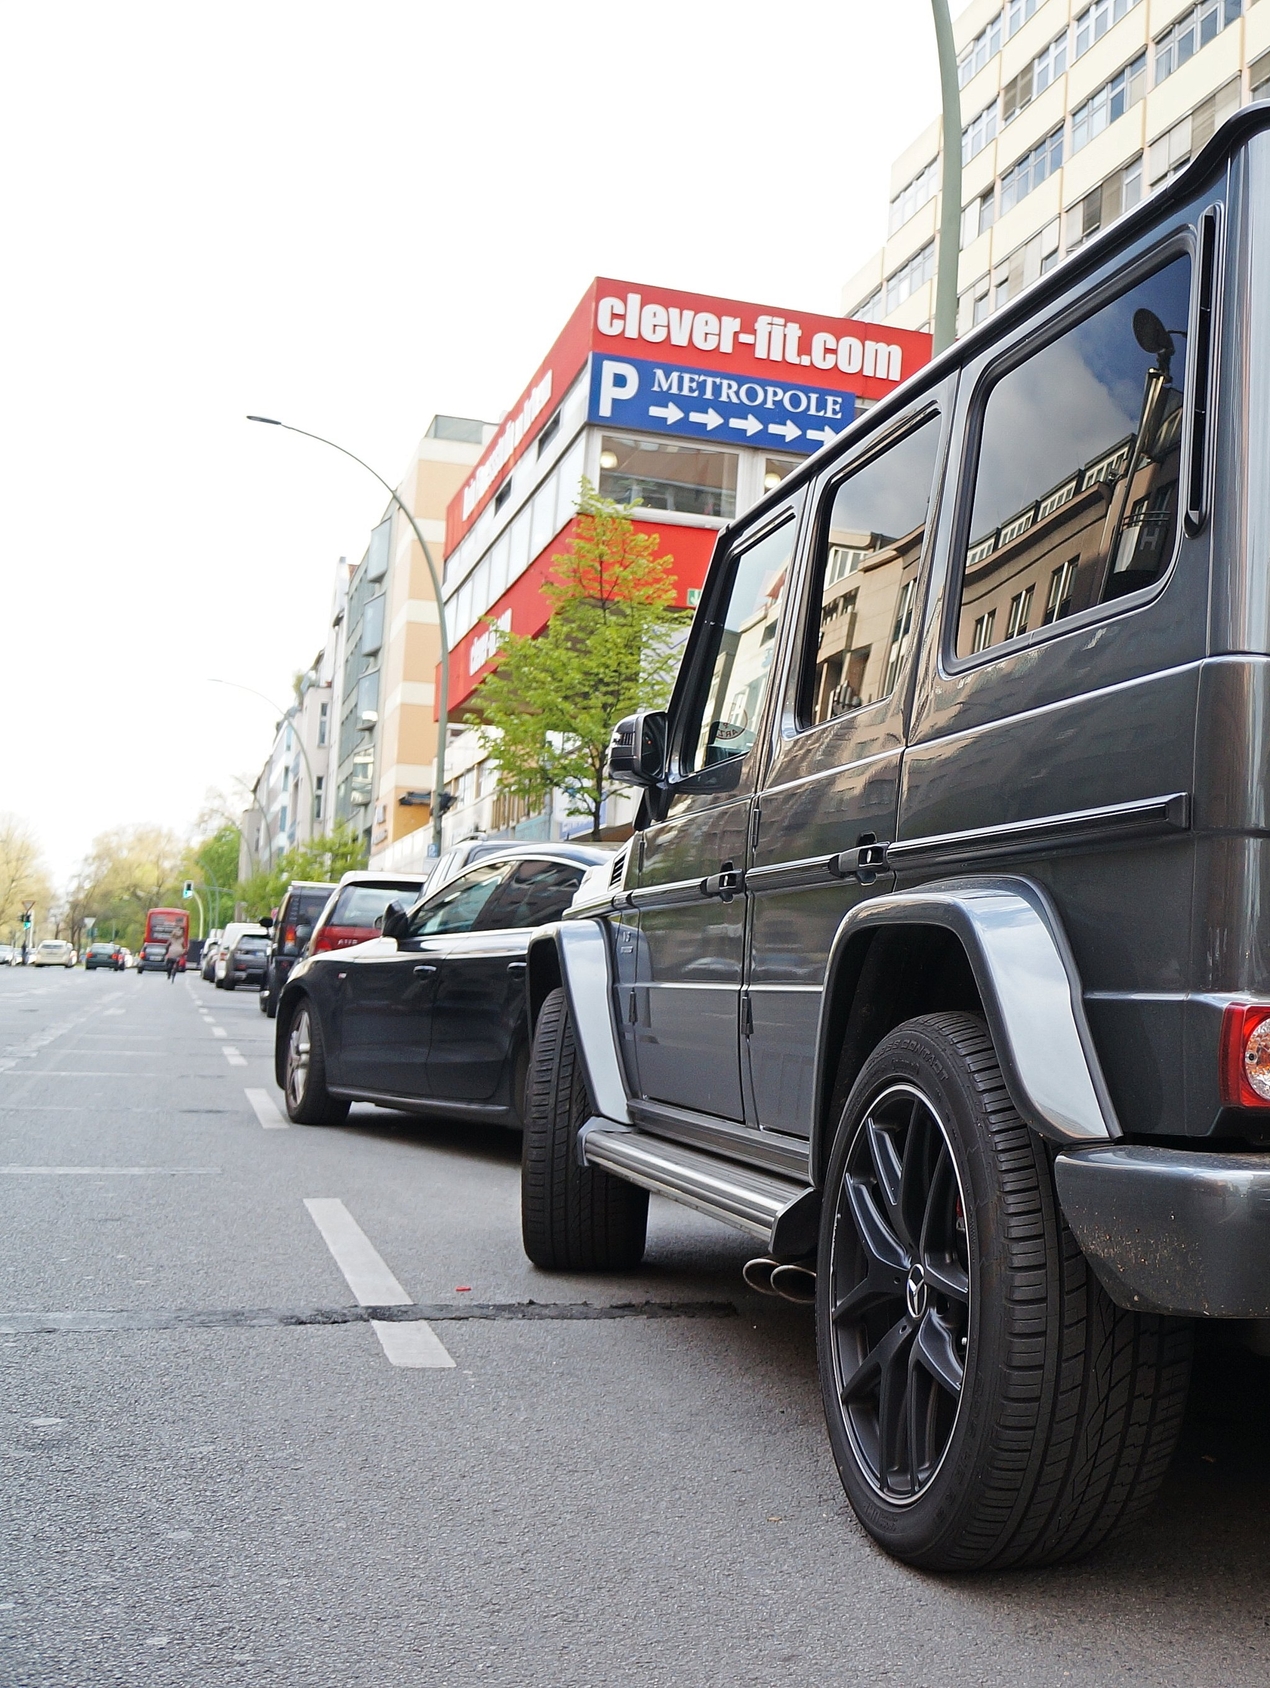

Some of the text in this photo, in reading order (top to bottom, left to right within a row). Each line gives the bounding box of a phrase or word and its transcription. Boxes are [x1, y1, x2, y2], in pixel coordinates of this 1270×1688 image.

[596, 292, 903, 382] clever-fit.com
[598, 359, 843, 420] P METROPOLE
